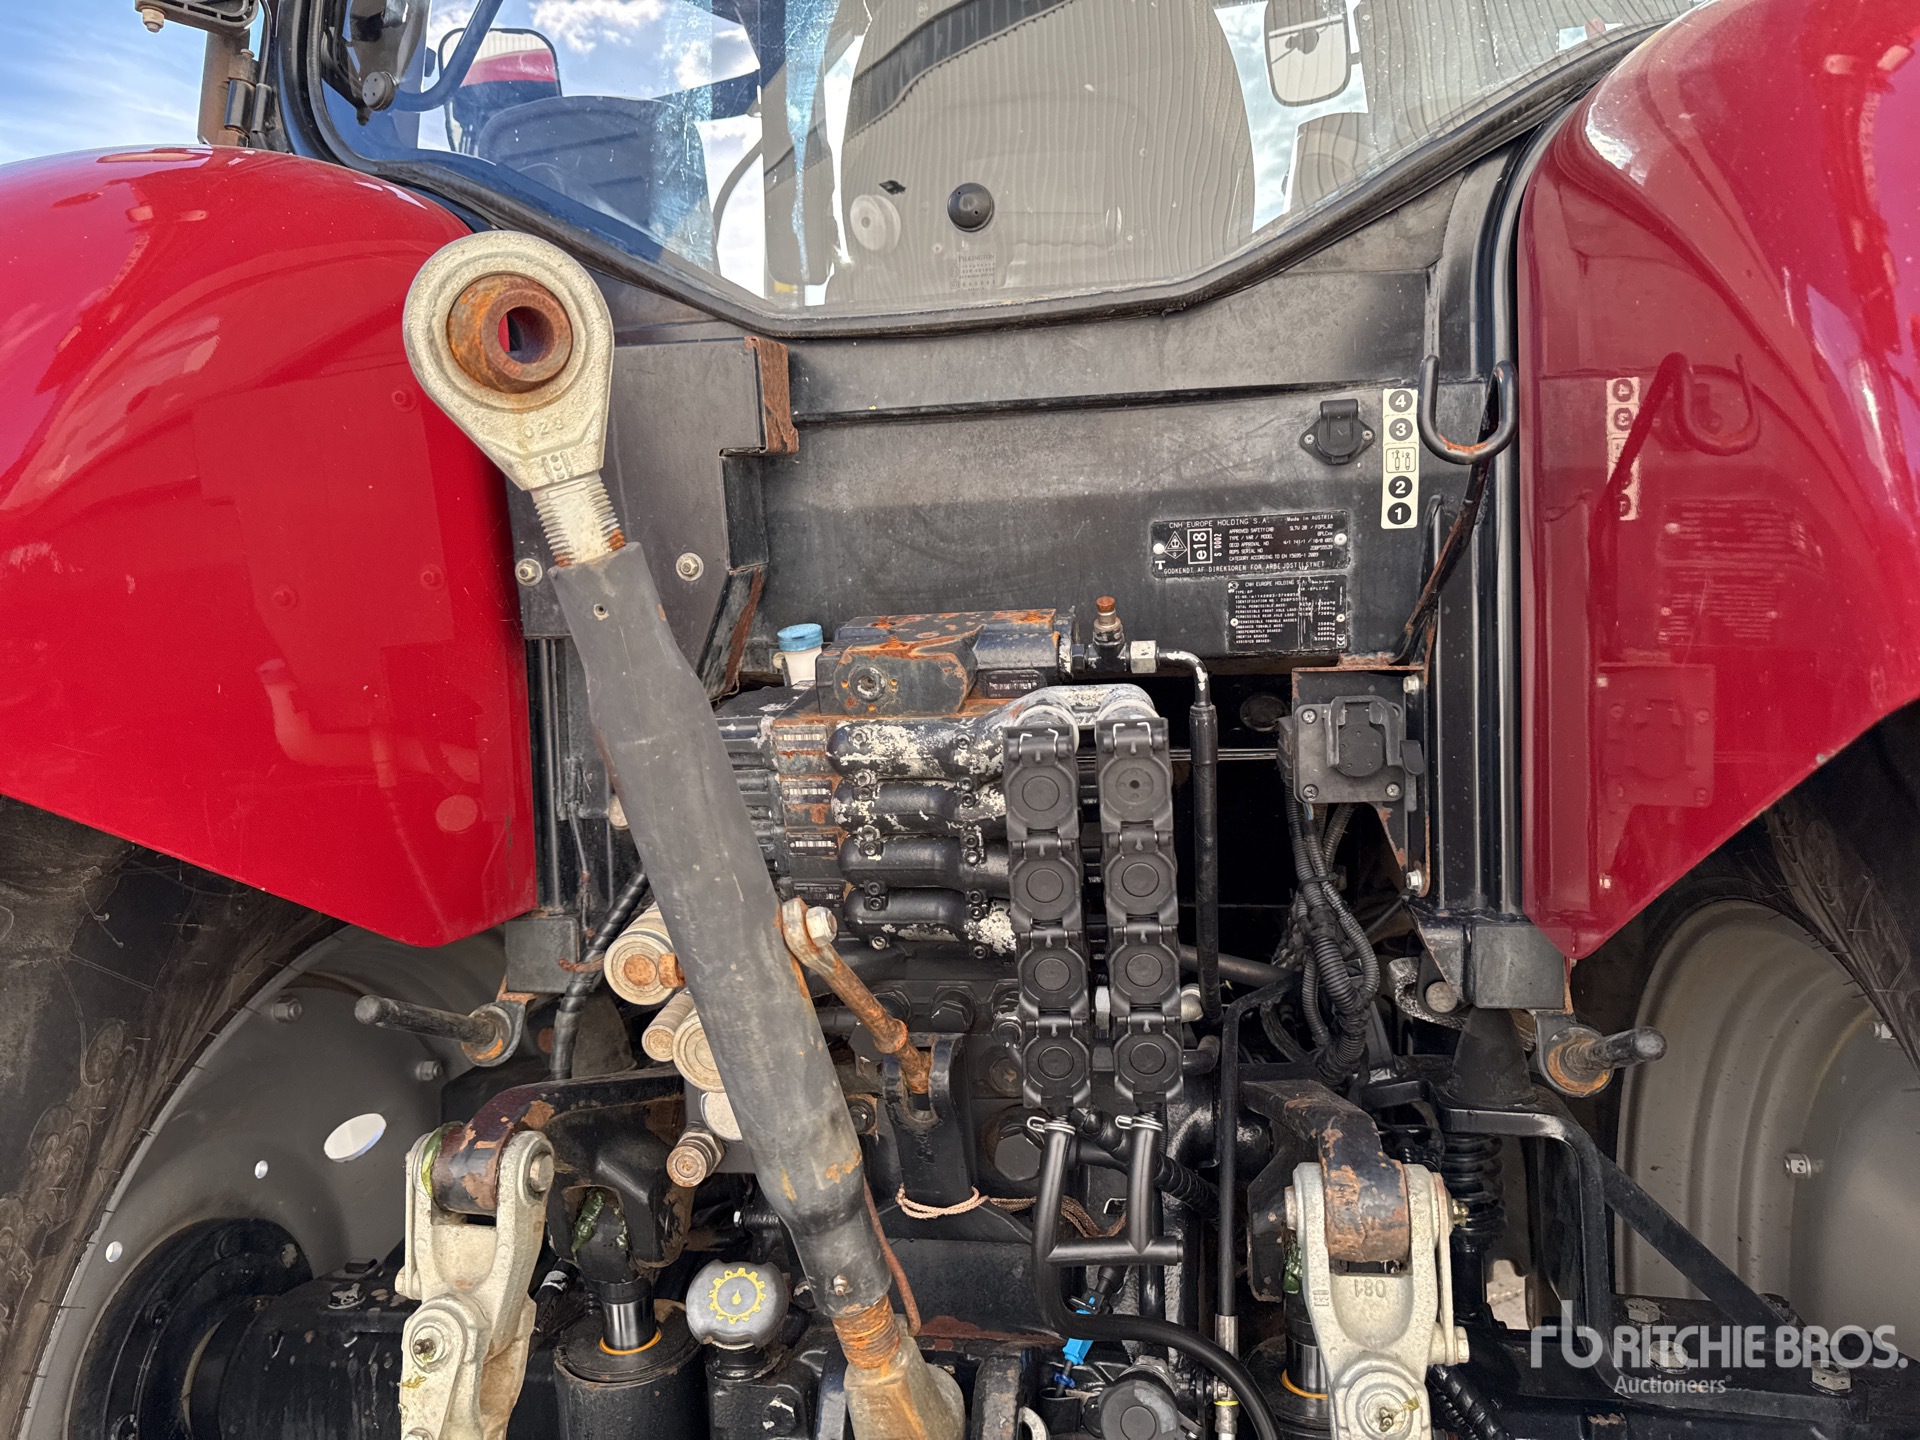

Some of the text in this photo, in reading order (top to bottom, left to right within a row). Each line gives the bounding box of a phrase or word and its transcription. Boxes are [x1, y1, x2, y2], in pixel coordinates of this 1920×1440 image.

[1395, 394, 1406, 408] 4
[1396, 423, 1406, 436] 3
[1395, 480, 1406, 494] 2
[1395, 508, 1403, 520] 1
[1192, 532, 1207, 560] e18
